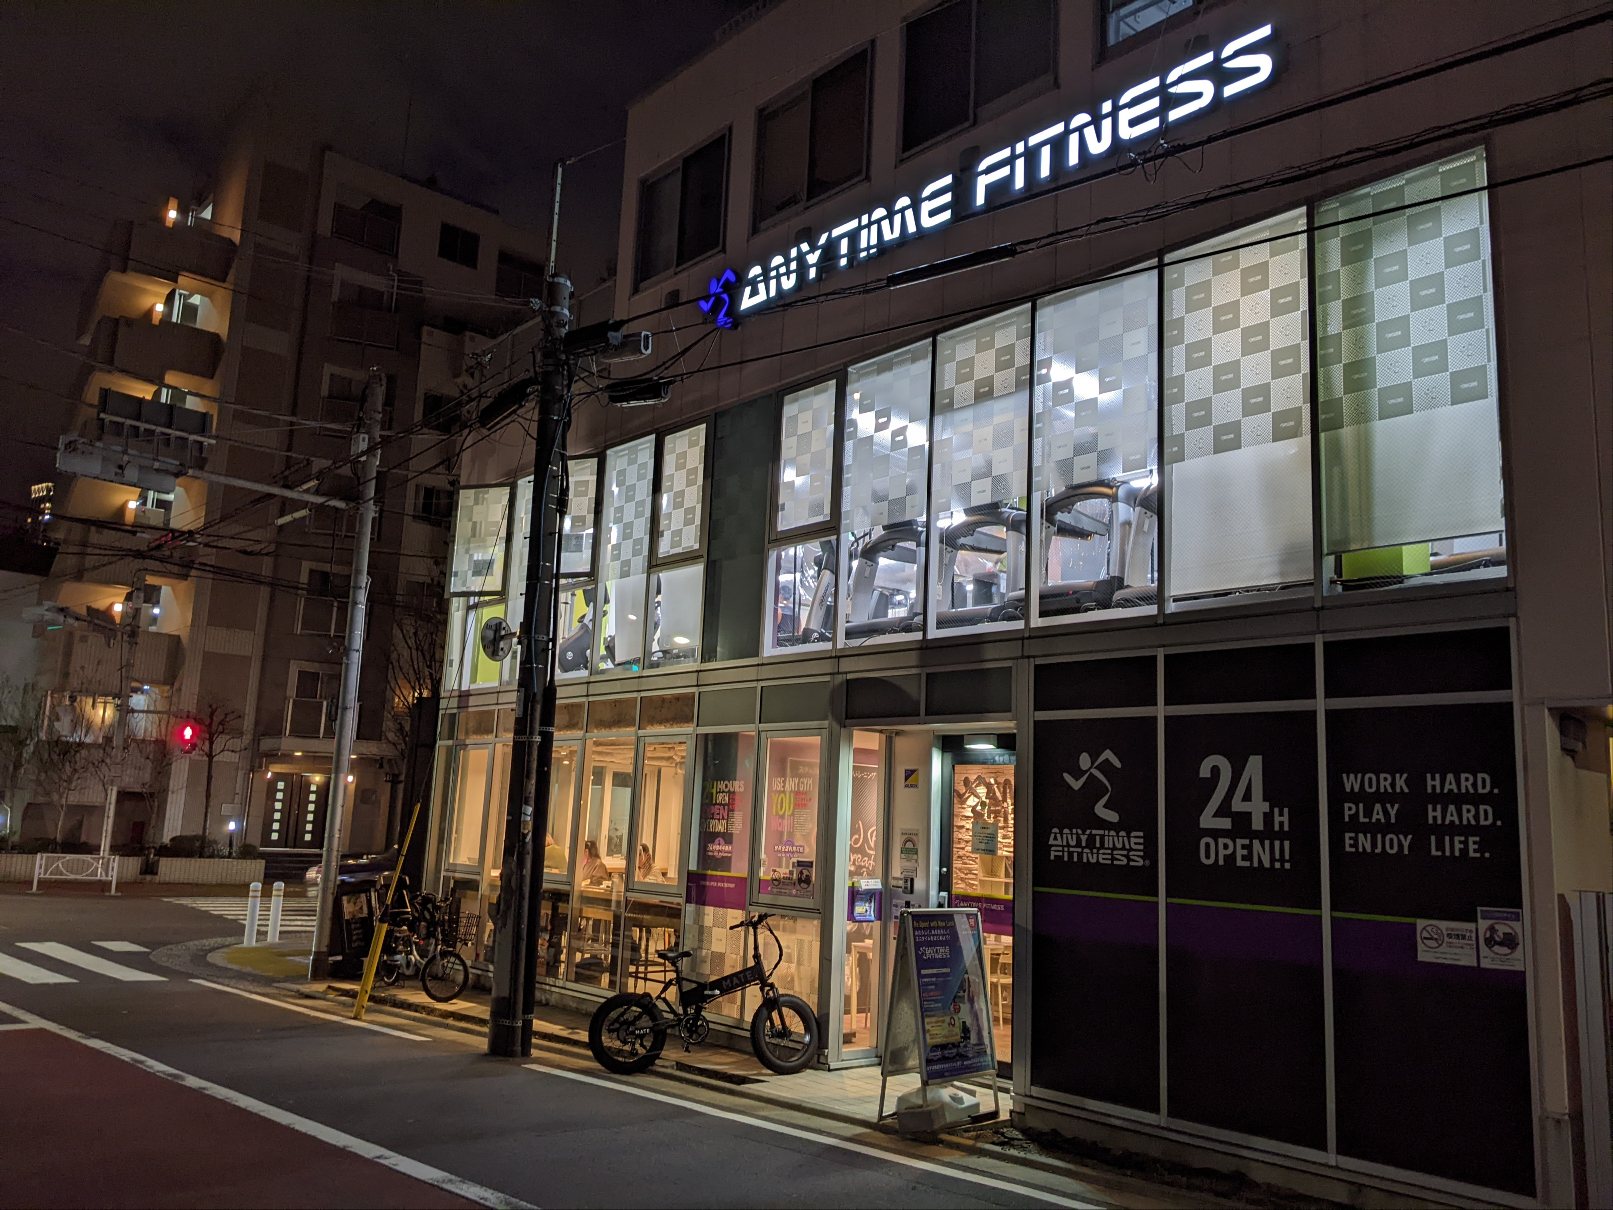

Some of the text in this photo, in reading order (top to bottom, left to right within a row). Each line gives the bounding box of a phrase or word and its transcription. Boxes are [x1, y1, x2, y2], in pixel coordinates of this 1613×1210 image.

[740, 24, 1274, 311] ANYTIME FITNESS
[717, 780, 745, 793] HOURS
[772, 777, 813, 791] USE ANY GYM
[1342, 772, 1500, 795] WORK HARD.
[771, 791, 794, 816] YOU
[1343, 802, 1503, 826] PLAY HARD.
[1048, 827, 1144, 850] ANYTIME
[1344, 832, 1491, 858] ENJOY LIFE.
[1049, 846, 1145, 867] FITNESS
[1199, 836, 1291, 870] OPEN!!
[721, 970, 754, 990] MATE
